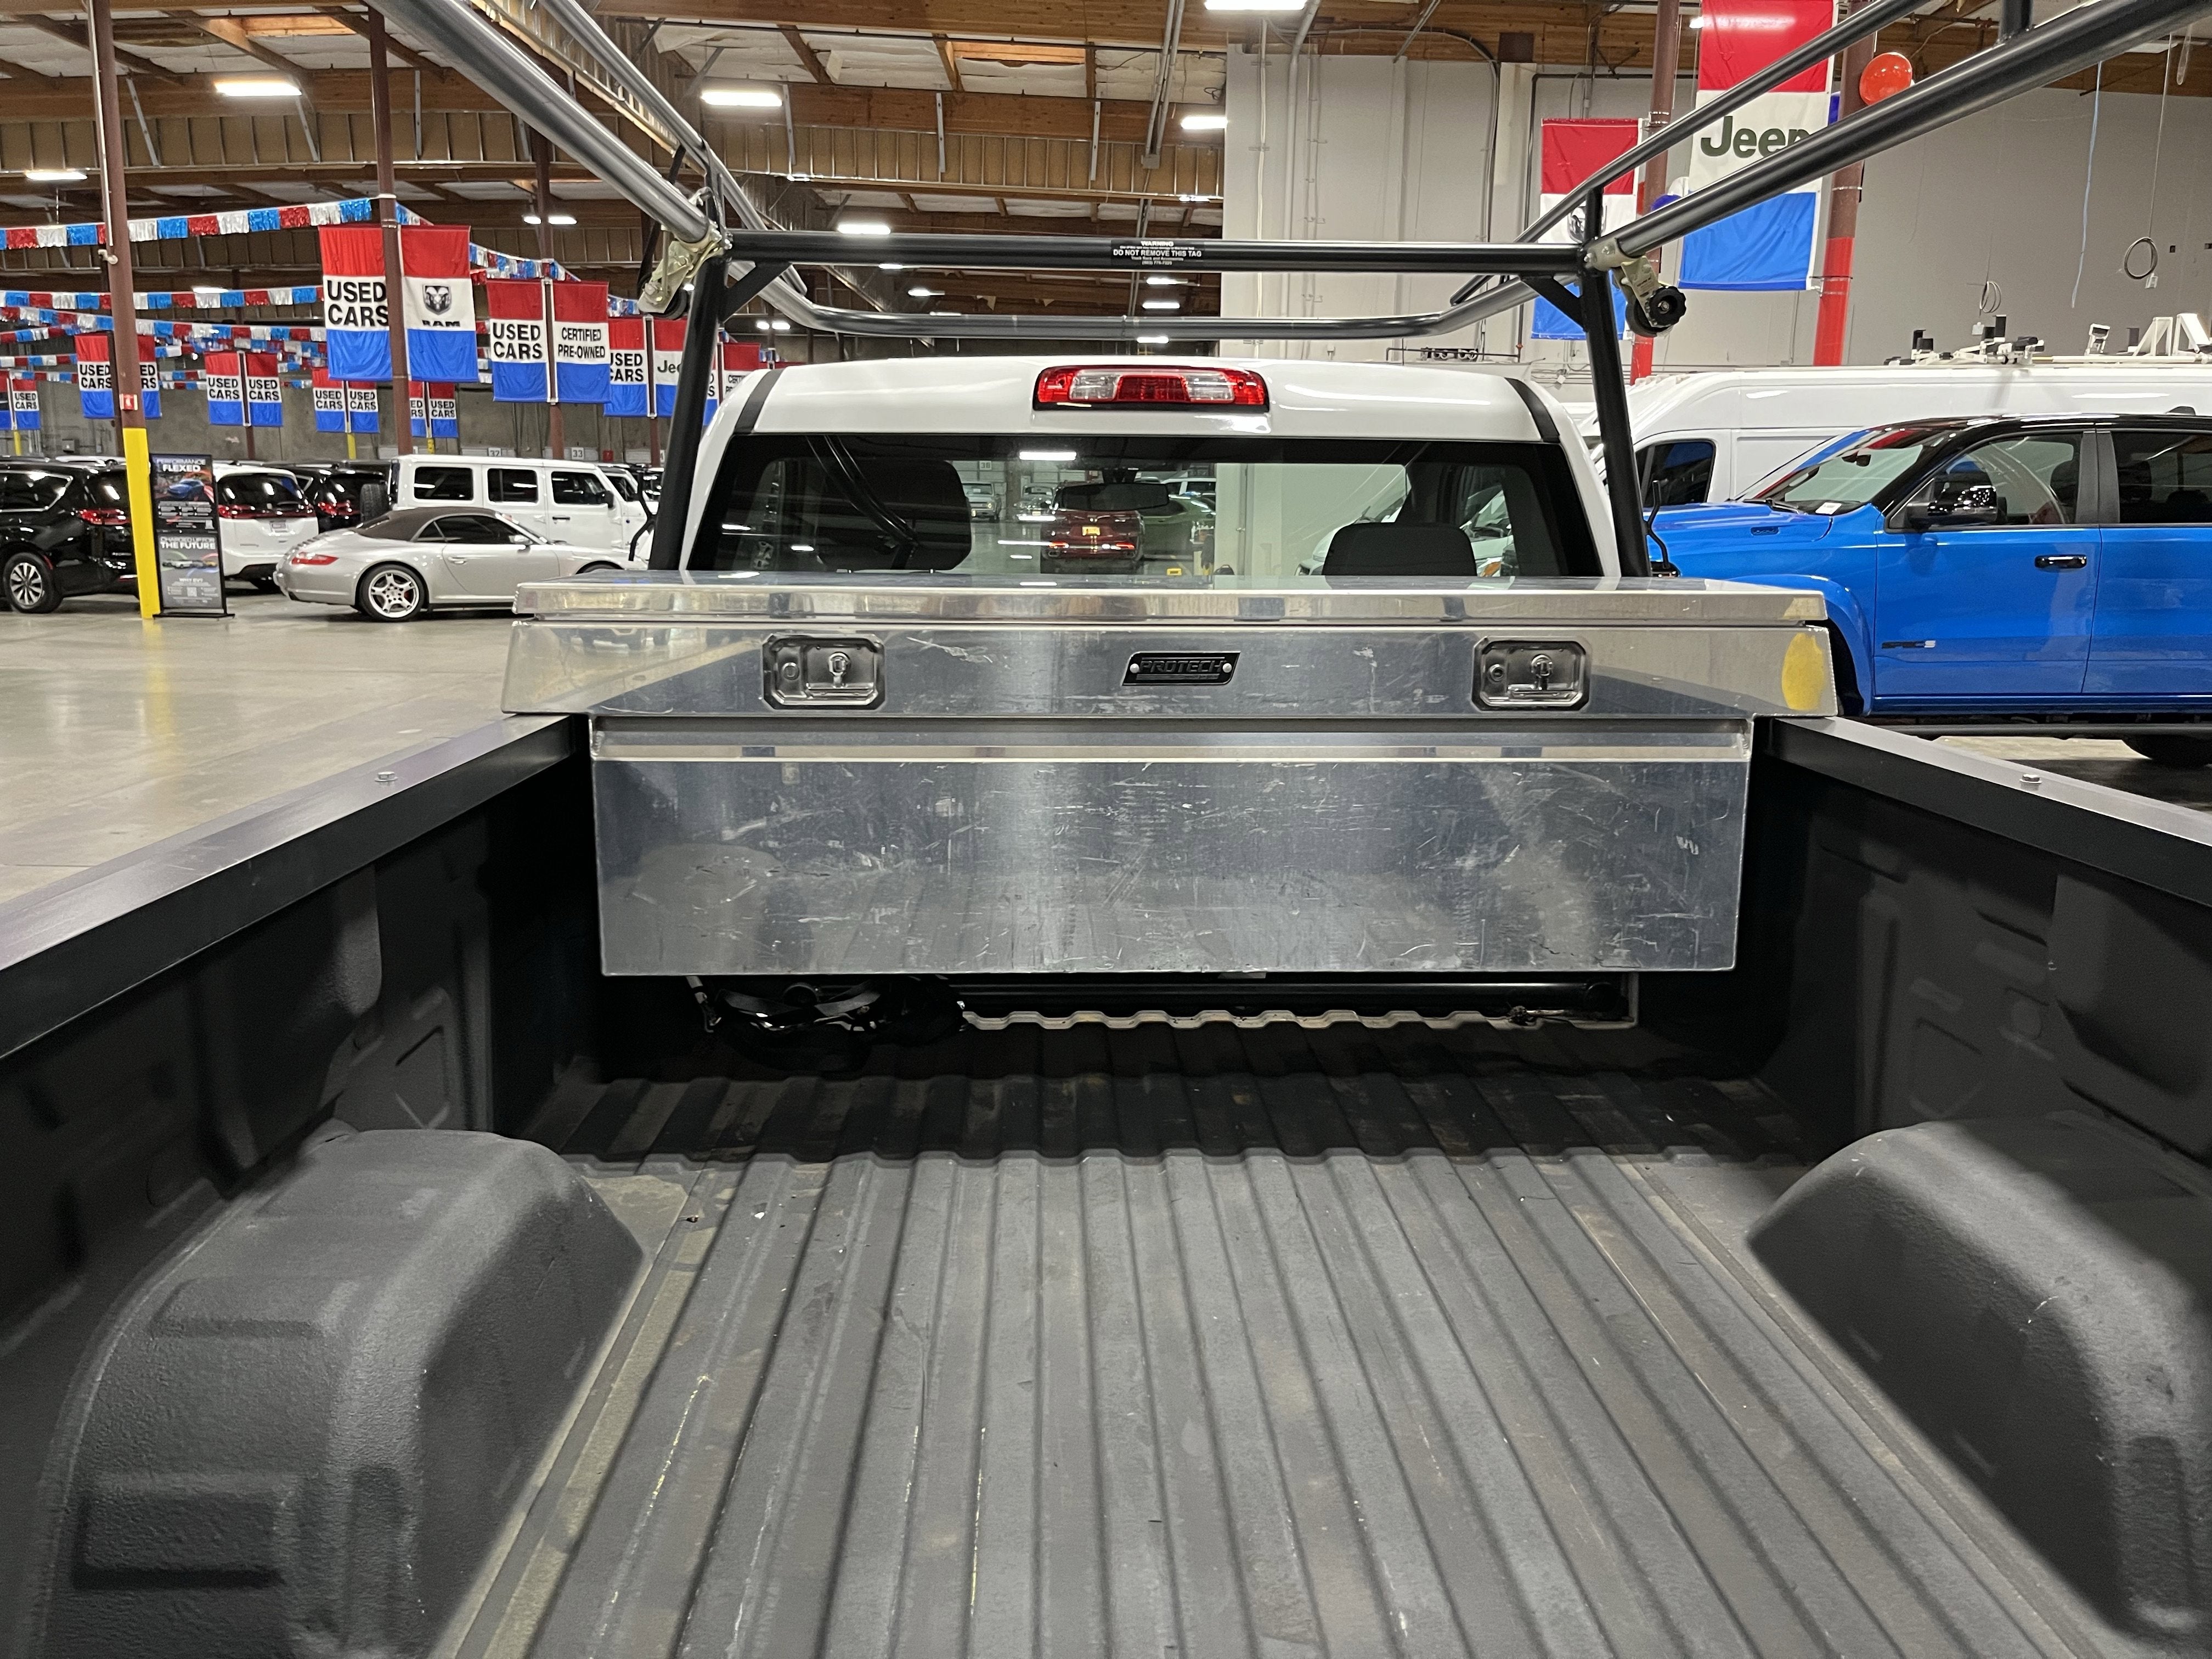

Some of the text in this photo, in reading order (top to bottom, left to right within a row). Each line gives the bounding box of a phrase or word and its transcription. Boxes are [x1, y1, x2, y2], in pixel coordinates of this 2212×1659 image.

[327, 280, 387, 302] USED
[328, 304, 389, 327] CARS
[493, 322, 541, 341] USED
[561, 327, 601, 342] CERTIFIED
[493, 341, 543, 360] CARS
[558, 343, 606, 359] PRE-OWNED
[80, 364, 110, 376] USED
[81, 377, 111, 389] CARS
[208, 377, 238, 388] USED
[249, 379, 278, 390] USED
[14, 393, 36, 401] USED
[209, 389, 240, 399] CARS
[249, 390, 279, 400] CARS
[315, 390, 342, 399] USED
[350, 391, 375, 400] USED
[316, 400, 343, 409] CARS
[351, 400, 376, 410] CARS
[431, 400, 454, 409] USED
[431, 409, 455, 417] CARS
[573, 449, 583, 458] 33
[162, 464, 201, 472] FLEXED
[1140, 660, 1227, 673] PROTECH
